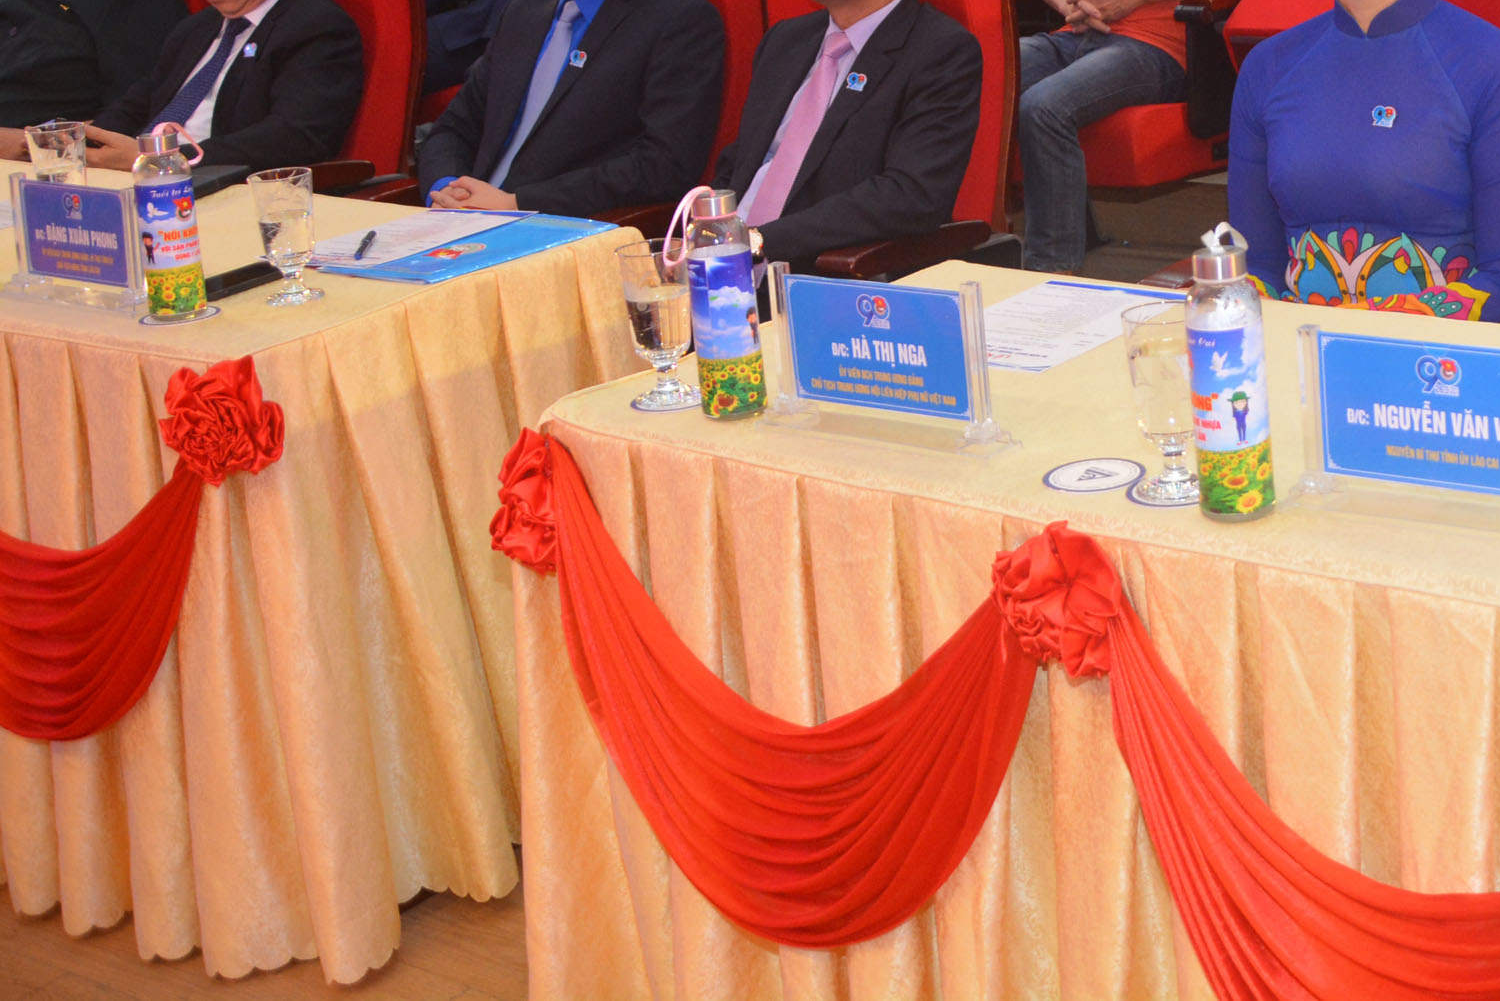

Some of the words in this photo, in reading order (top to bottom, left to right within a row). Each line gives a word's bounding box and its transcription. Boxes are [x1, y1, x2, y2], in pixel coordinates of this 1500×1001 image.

[851, 334, 871, 360] HÀ
[872, 339, 896, 367] THỊ
[898, 342, 928, 367] NGA
[1373, 400, 1447, 435] NGUYỄN
[1451, 409, 1489, 440] VĂN
